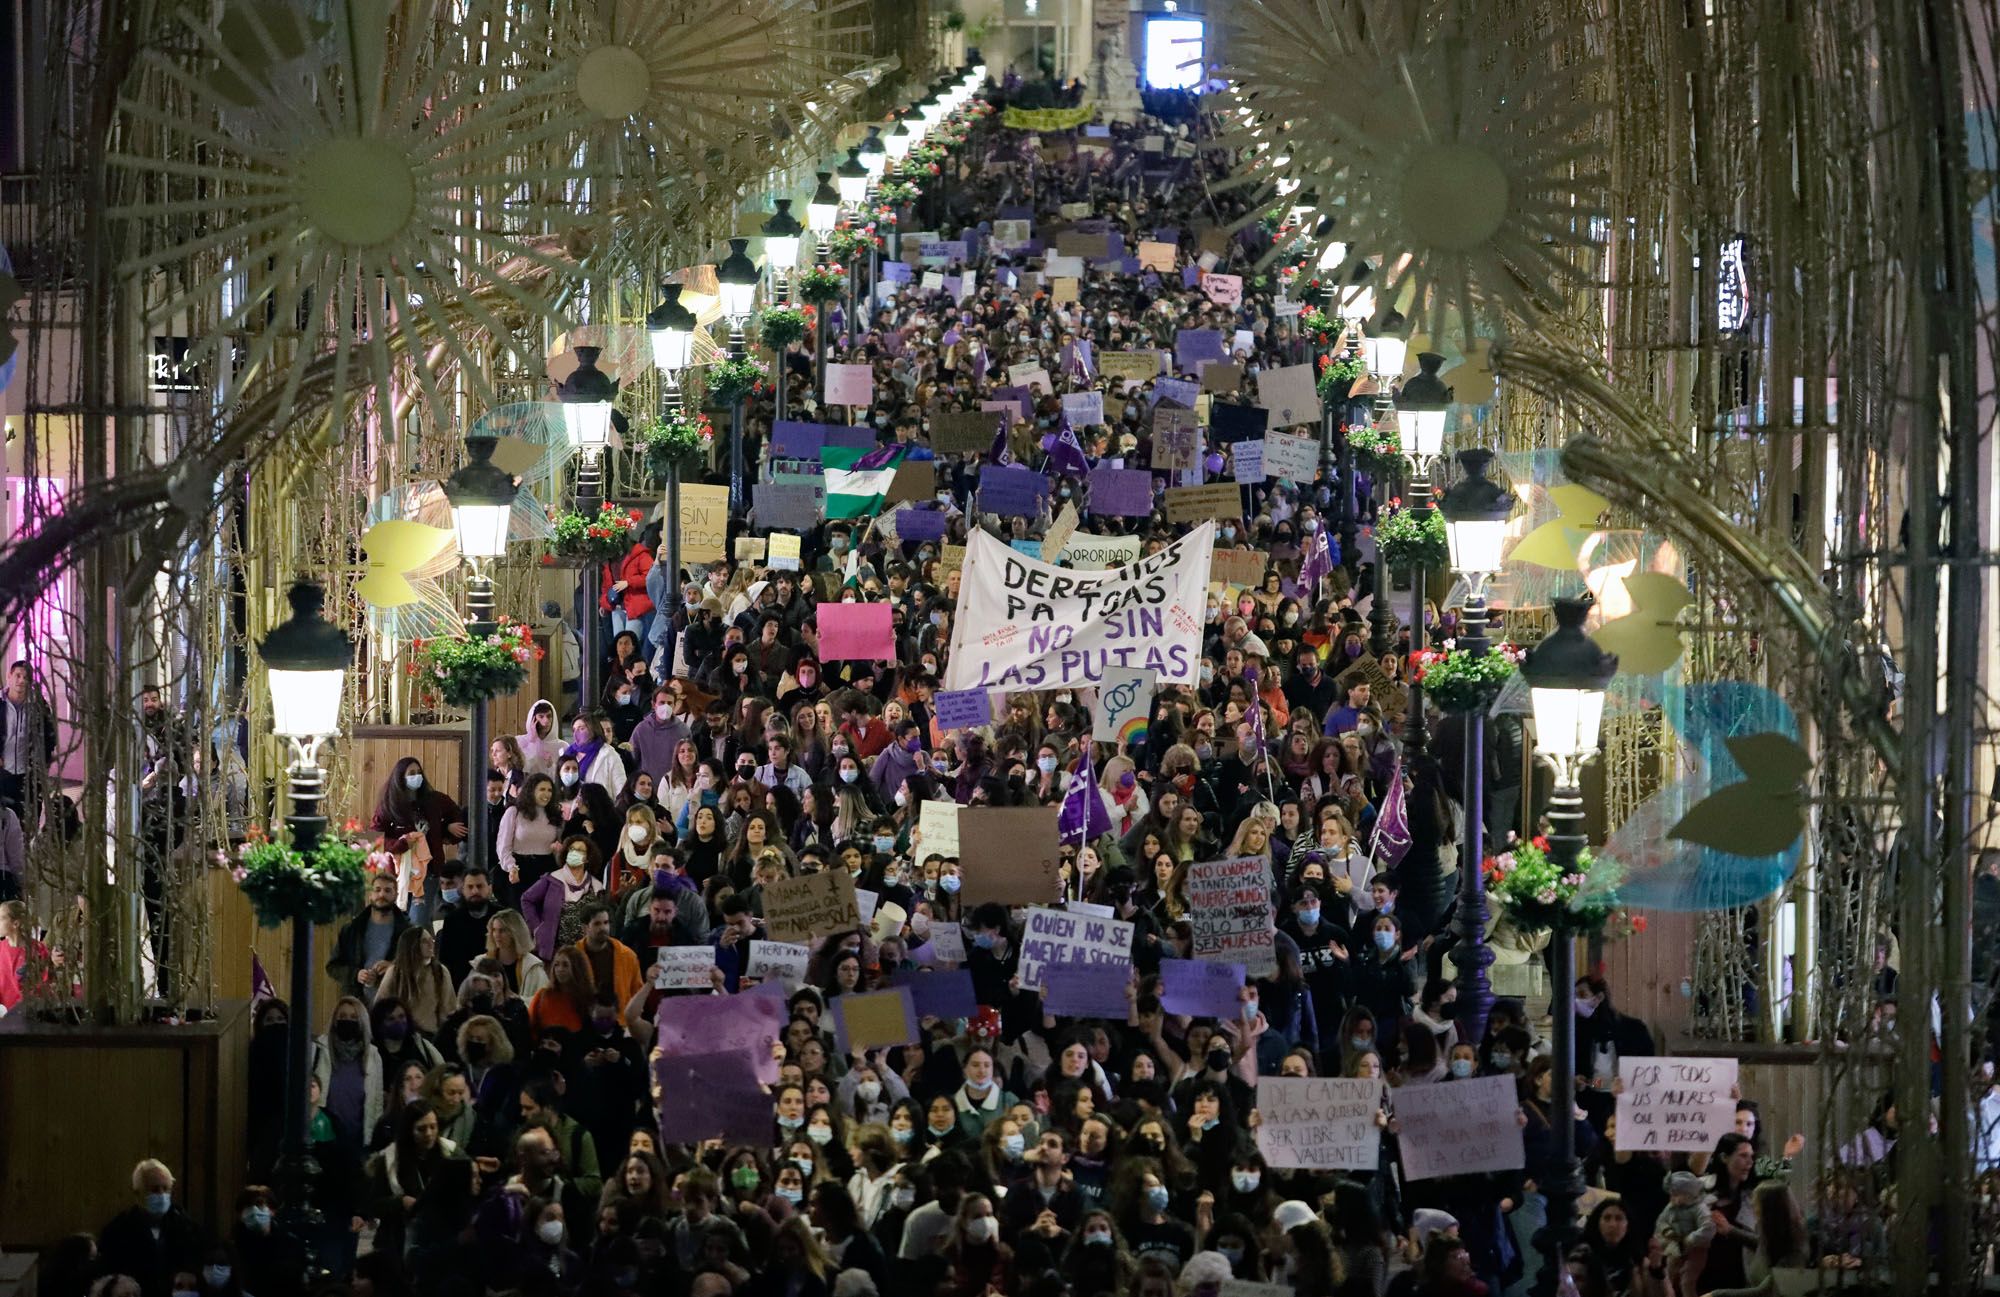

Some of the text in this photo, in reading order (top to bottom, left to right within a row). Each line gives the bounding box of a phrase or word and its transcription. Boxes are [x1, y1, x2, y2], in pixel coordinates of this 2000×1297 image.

[682, 527, 724, 549] iEDO
[1028, 624, 1075, 655] NO
[1104, 607, 1164, 640] SIN
[977, 644, 1189, 688] LAS PUTAS
[1192, 866, 1213, 880] NO
[791, 917, 809, 934] NO
[1084, 921, 1106, 943] NO
[1109, 926, 1129, 948] SE
[1192, 918, 1266, 936] SOLO POR
[1194, 931, 1273, 953] SER MUJERES
[1631, 1065, 1662, 1087] POR
[1269, 1080, 1375, 1107] DE CAMINO
[1267, 1122, 1367, 1146] SER LIBRE NO
[1292, 1146, 1370, 1165] VALIENTE
